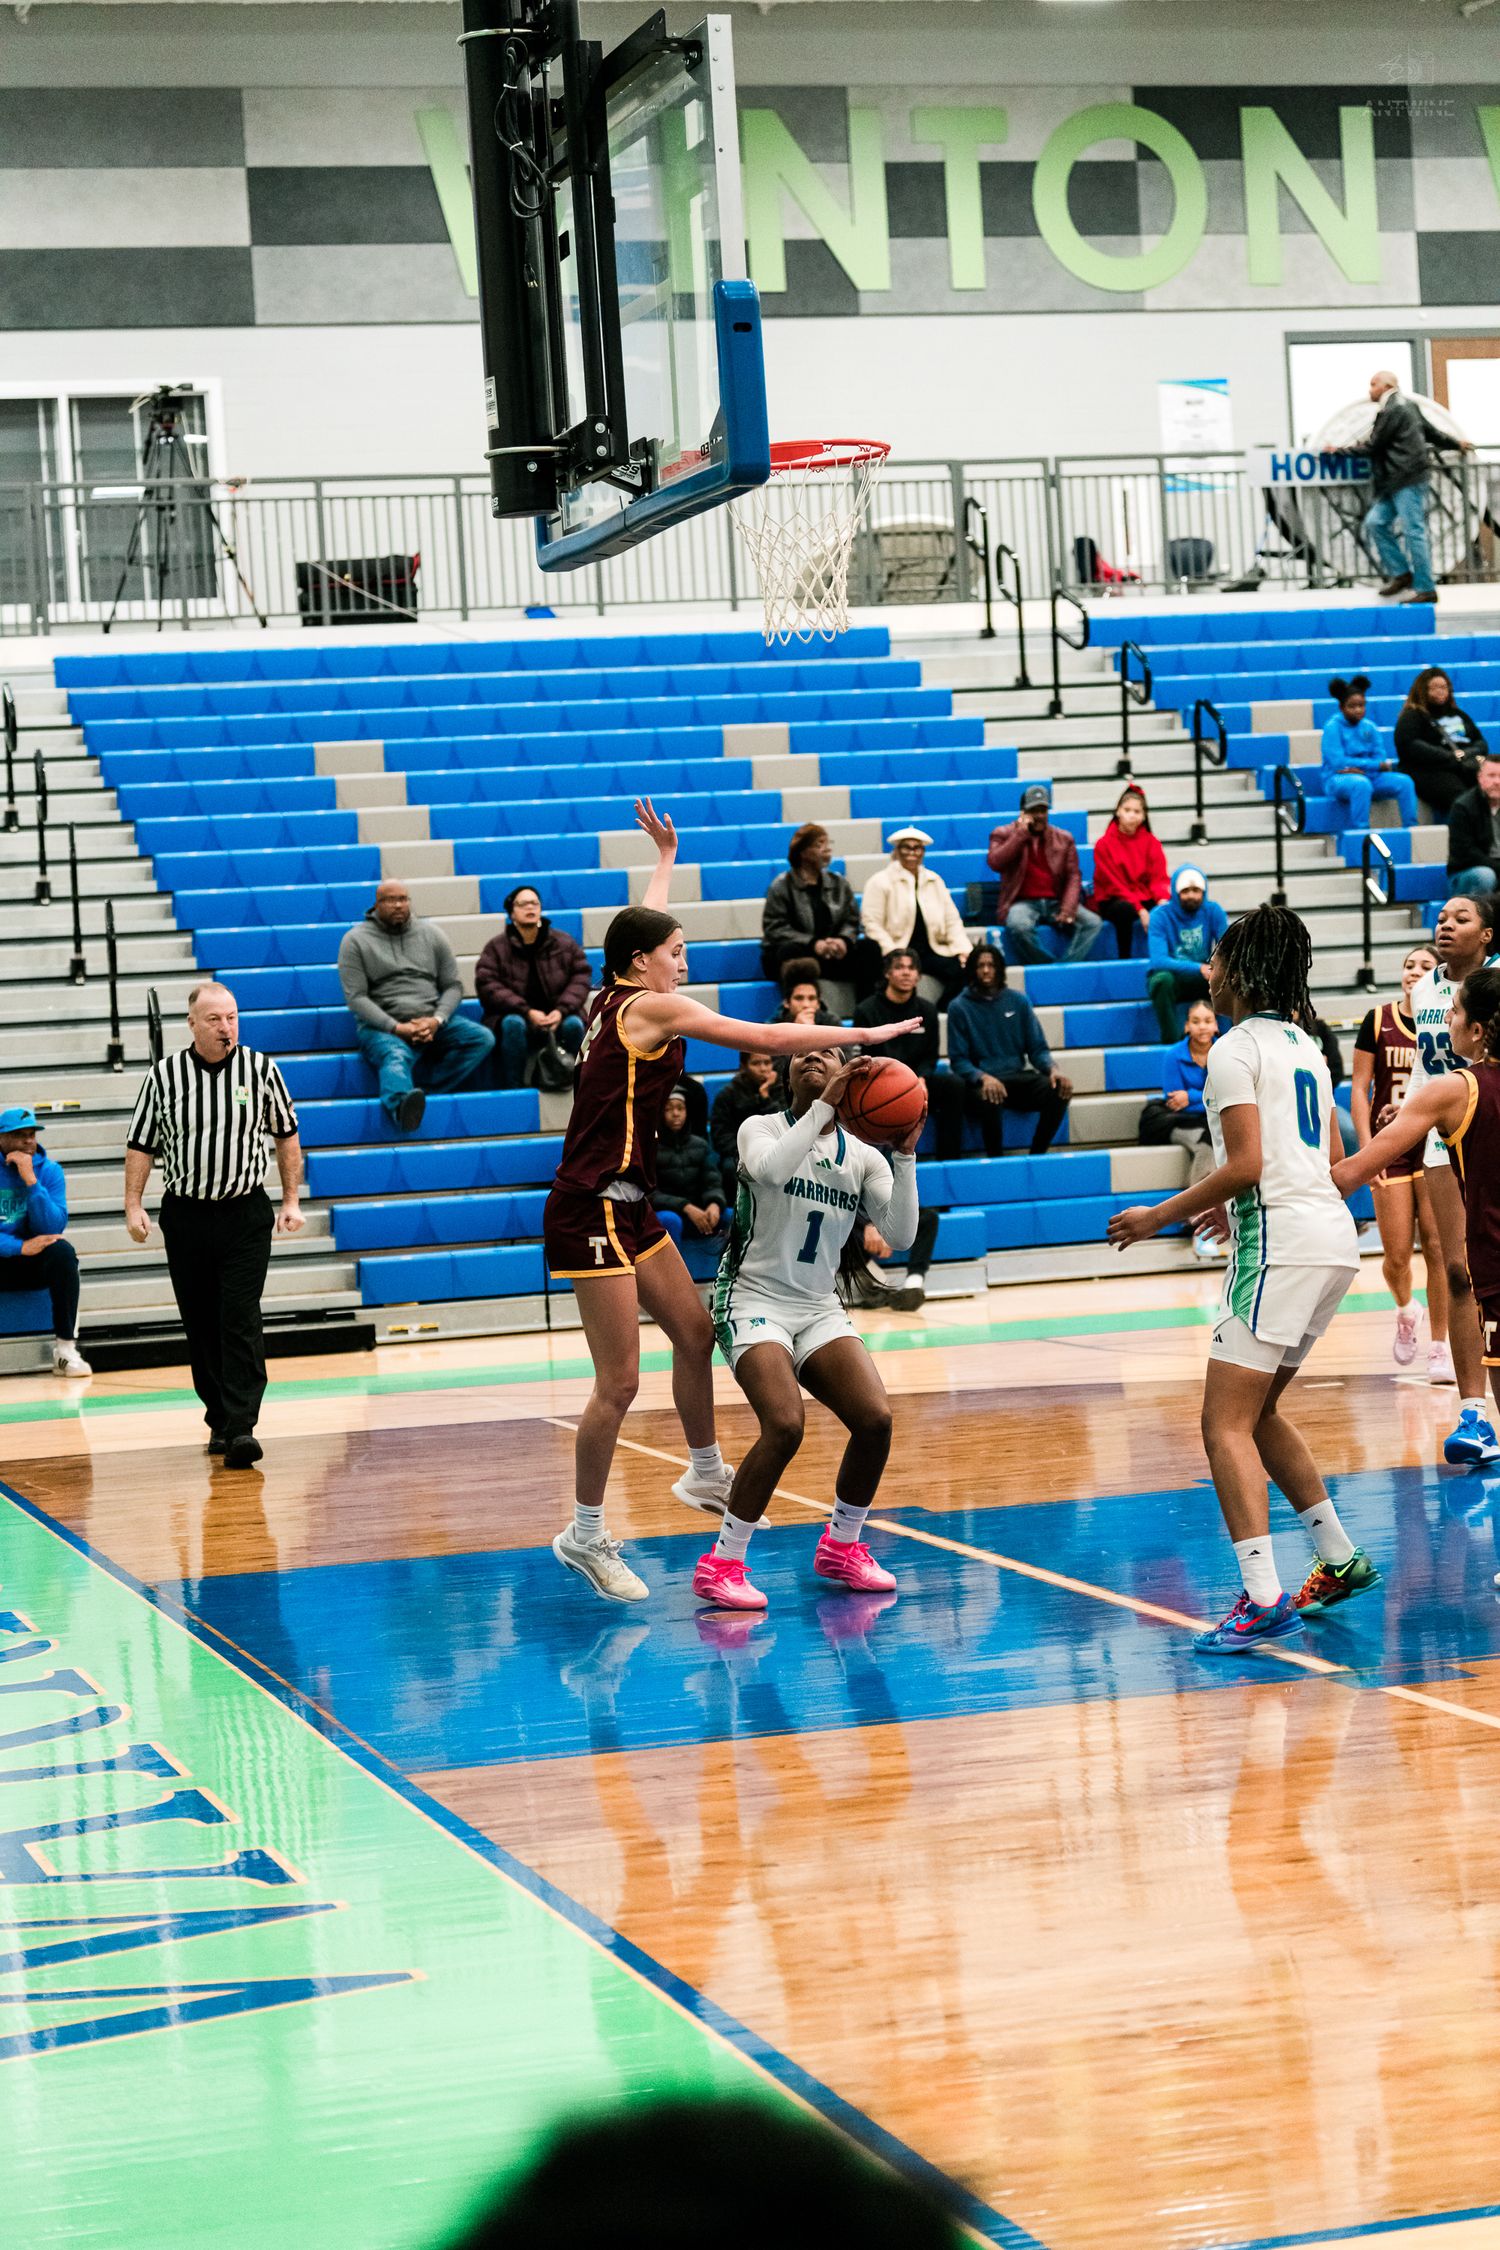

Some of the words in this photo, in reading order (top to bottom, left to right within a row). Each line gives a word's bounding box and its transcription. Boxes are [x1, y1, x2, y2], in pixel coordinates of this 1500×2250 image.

[1271, 452, 1371, 481] HOME
[1416, 1008, 1446, 1025] WARRI
[1418, 1031, 1468, 1076] 23
[1294, 1067, 1322, 1150] 0
[784, 1175, 859, 1213] WARRIORS
[588, 1236, 608, 1265] T
[796, 1210, 825, 1265] 1
